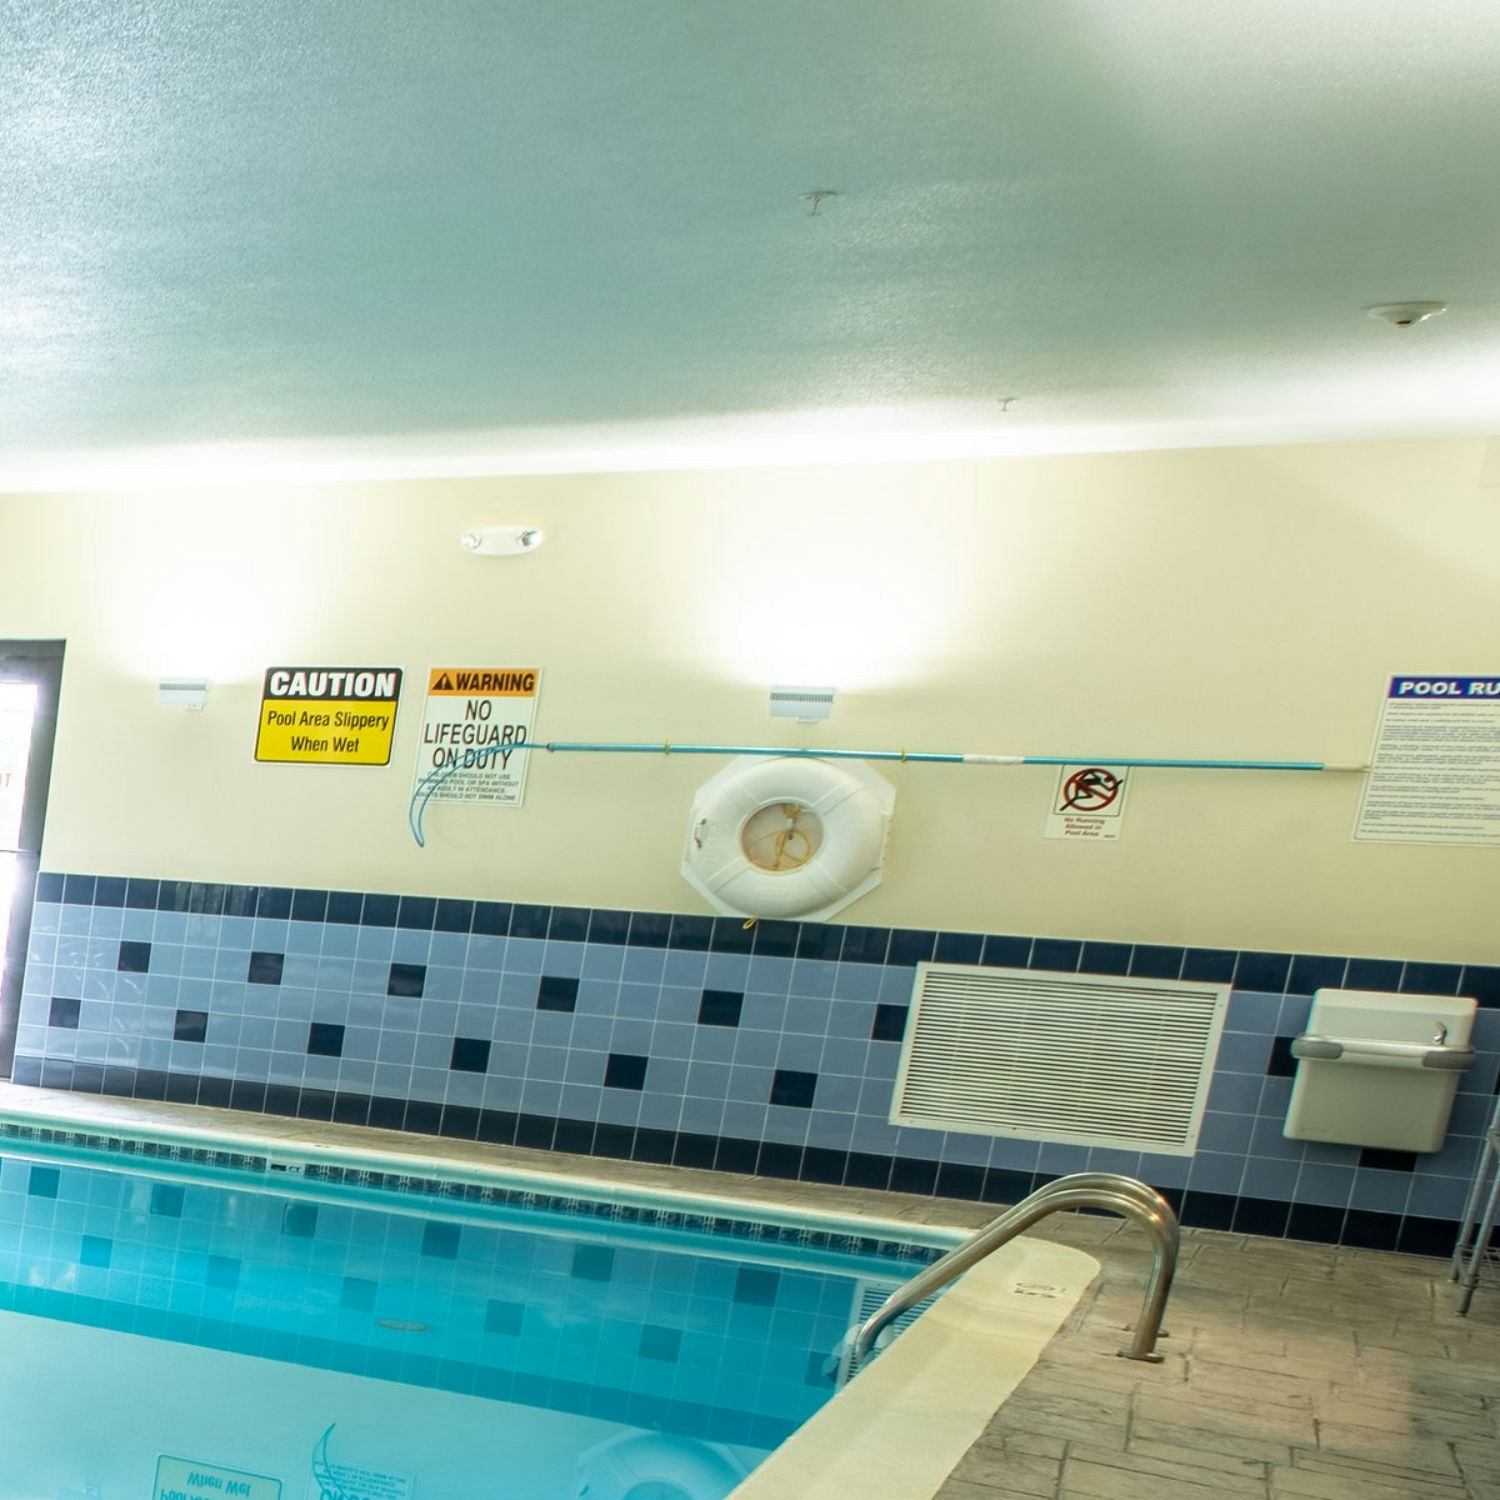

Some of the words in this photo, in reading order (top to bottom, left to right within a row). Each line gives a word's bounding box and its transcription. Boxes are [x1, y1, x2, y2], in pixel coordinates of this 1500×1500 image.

[269, 671, 397, 698] CAUTION
[455, 672, 536, 692] WARNING
[1398, 682, 1462, 695] POOL
[267, 710, 296, 726] Pool
[299, 713, 331, 727] Area
[334, 711, 390, 732] Slippery
[465, 699, 493, 721] NO
[291, 736, 328, 752] When
[333, 737, 360, 753] Wet
[423, 723, 528, 747] LIFEGUARD
[432, 747, 459, 769] ON
[463, 748, 513, 771] DUTY
